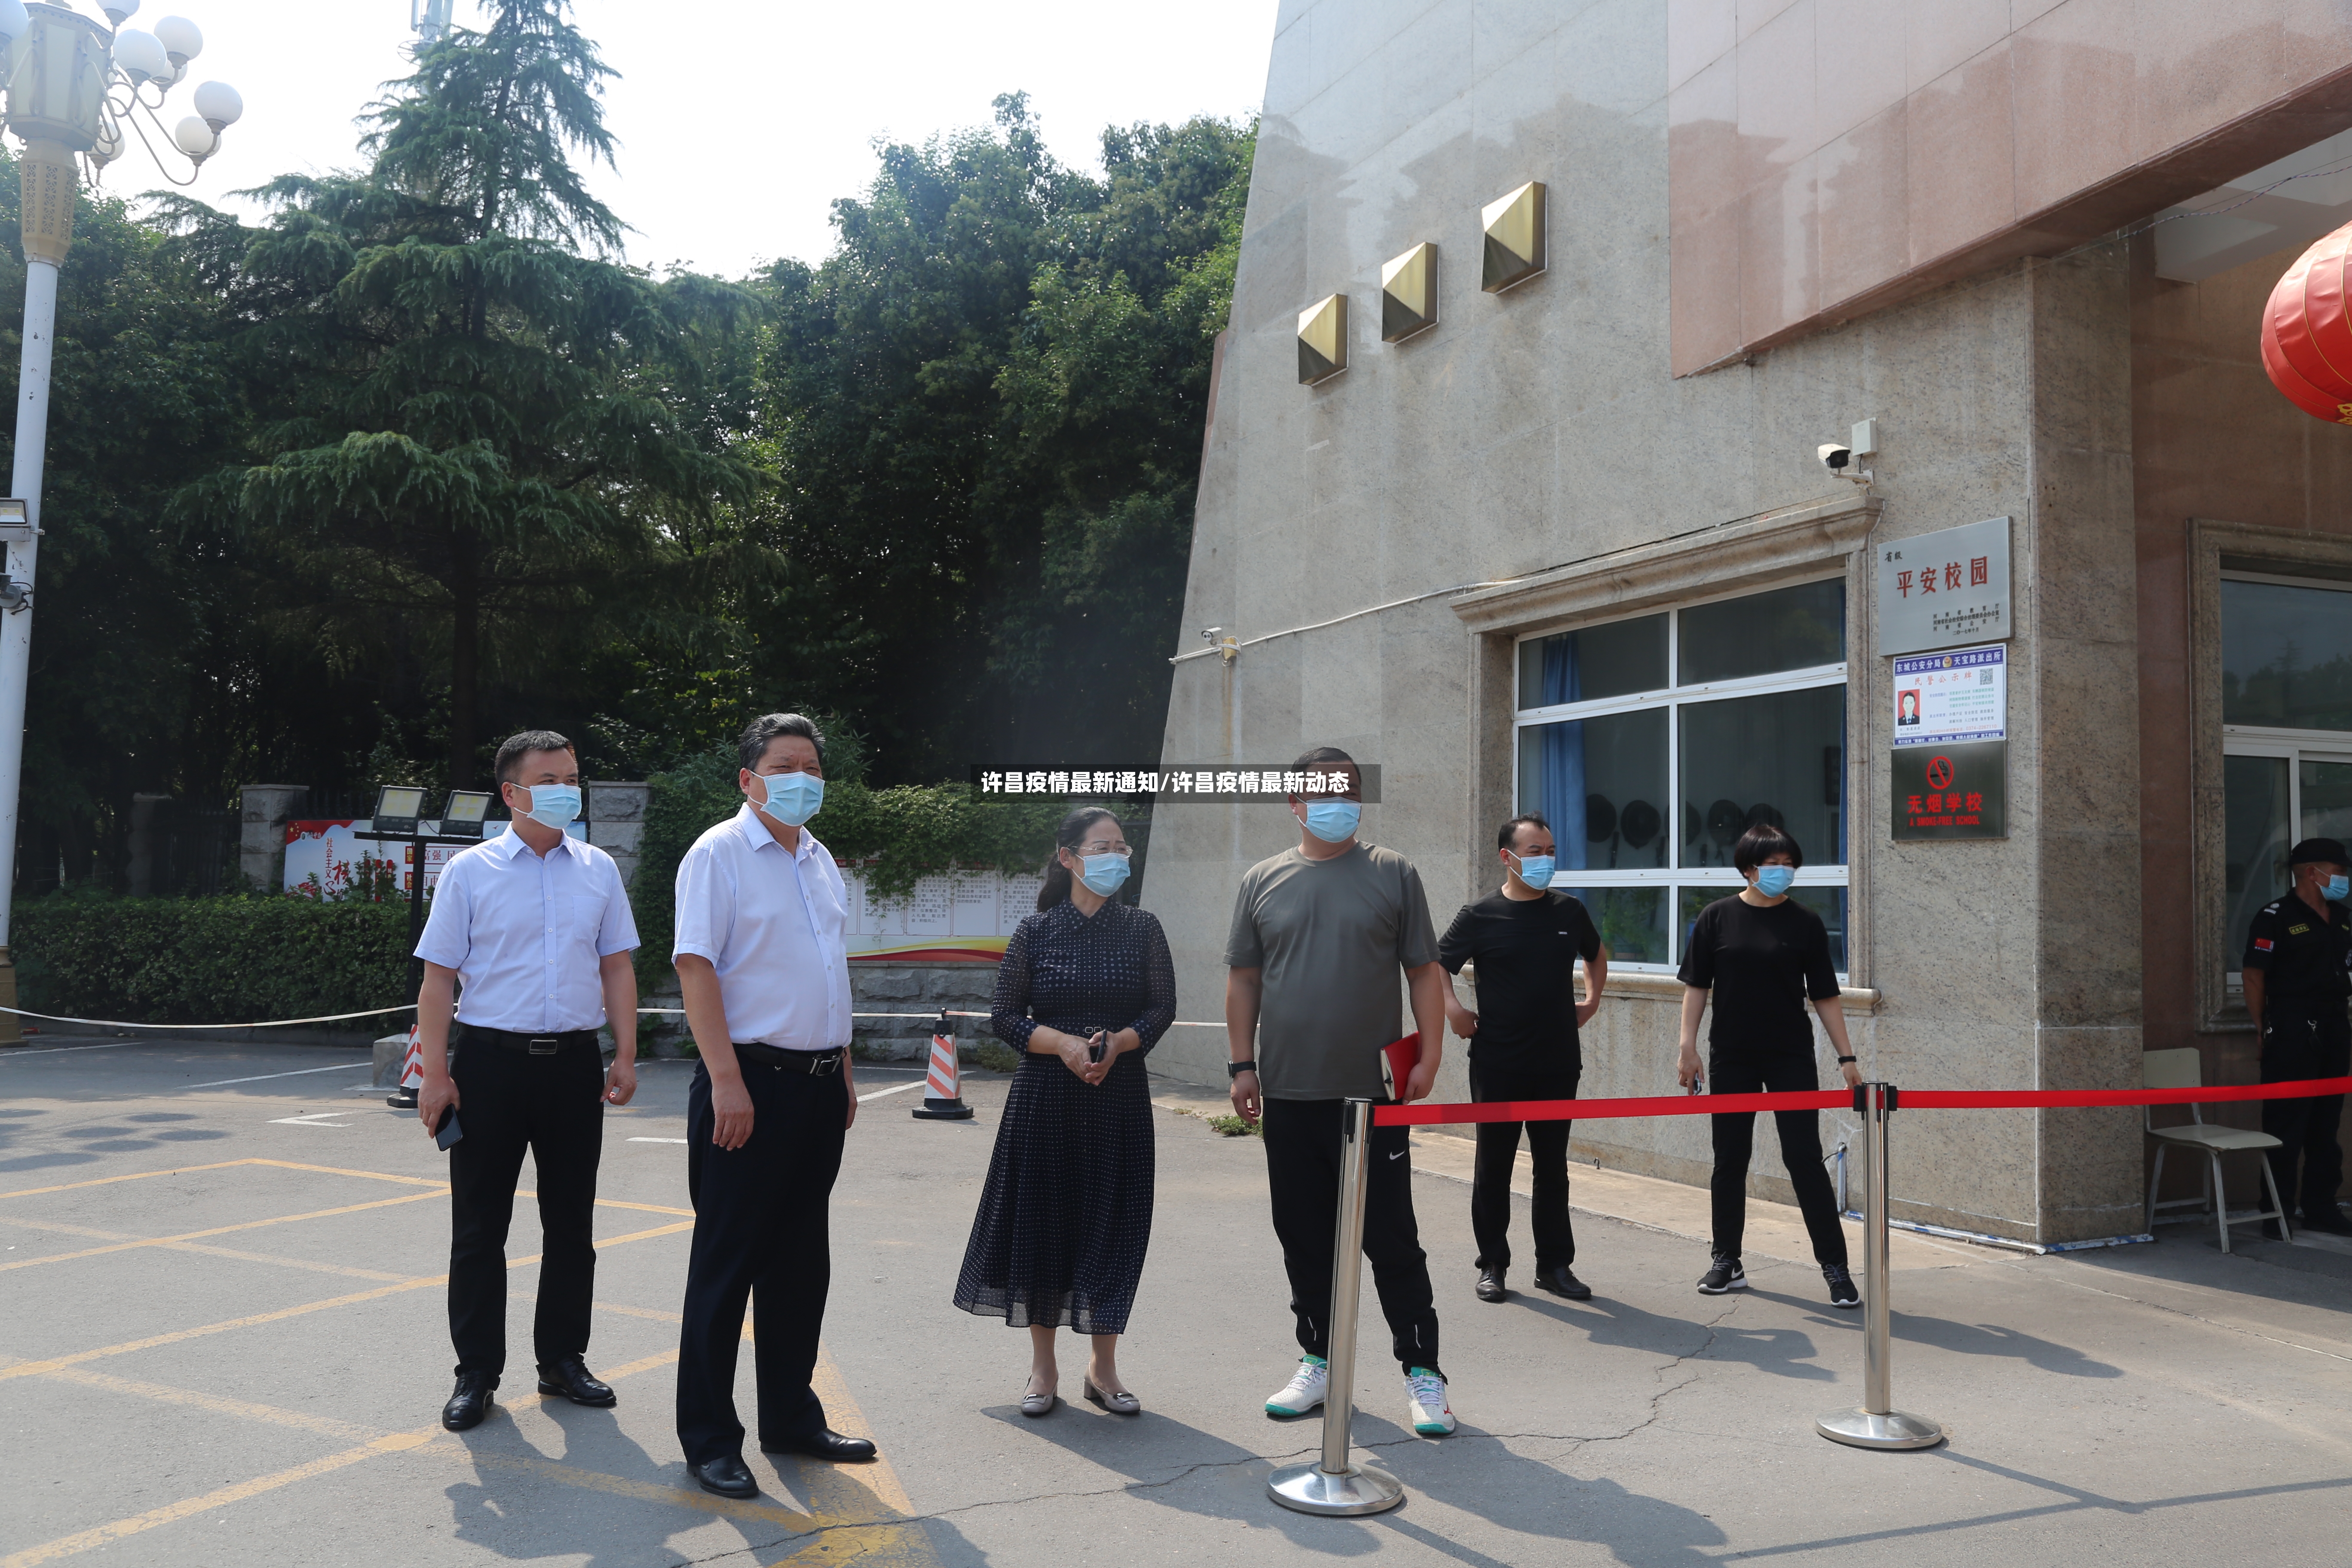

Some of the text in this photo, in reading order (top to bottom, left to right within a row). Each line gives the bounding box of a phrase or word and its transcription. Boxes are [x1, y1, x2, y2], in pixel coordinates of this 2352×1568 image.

[1885, 551, 1902, 562] 省级
[1897, 556, 1988, 598] 平安校园
[1896, 651, 2001, 672] 东城公安分局 天宝路派出所
[1915, 671, 1972, 686] 民警公示牌
[1907, 792, 1982, 814] 无烟学校
[1909, 815, 1980, 826] A SMOKE-FREE SCHOOL
[407, 874, 412, 888] 社会
